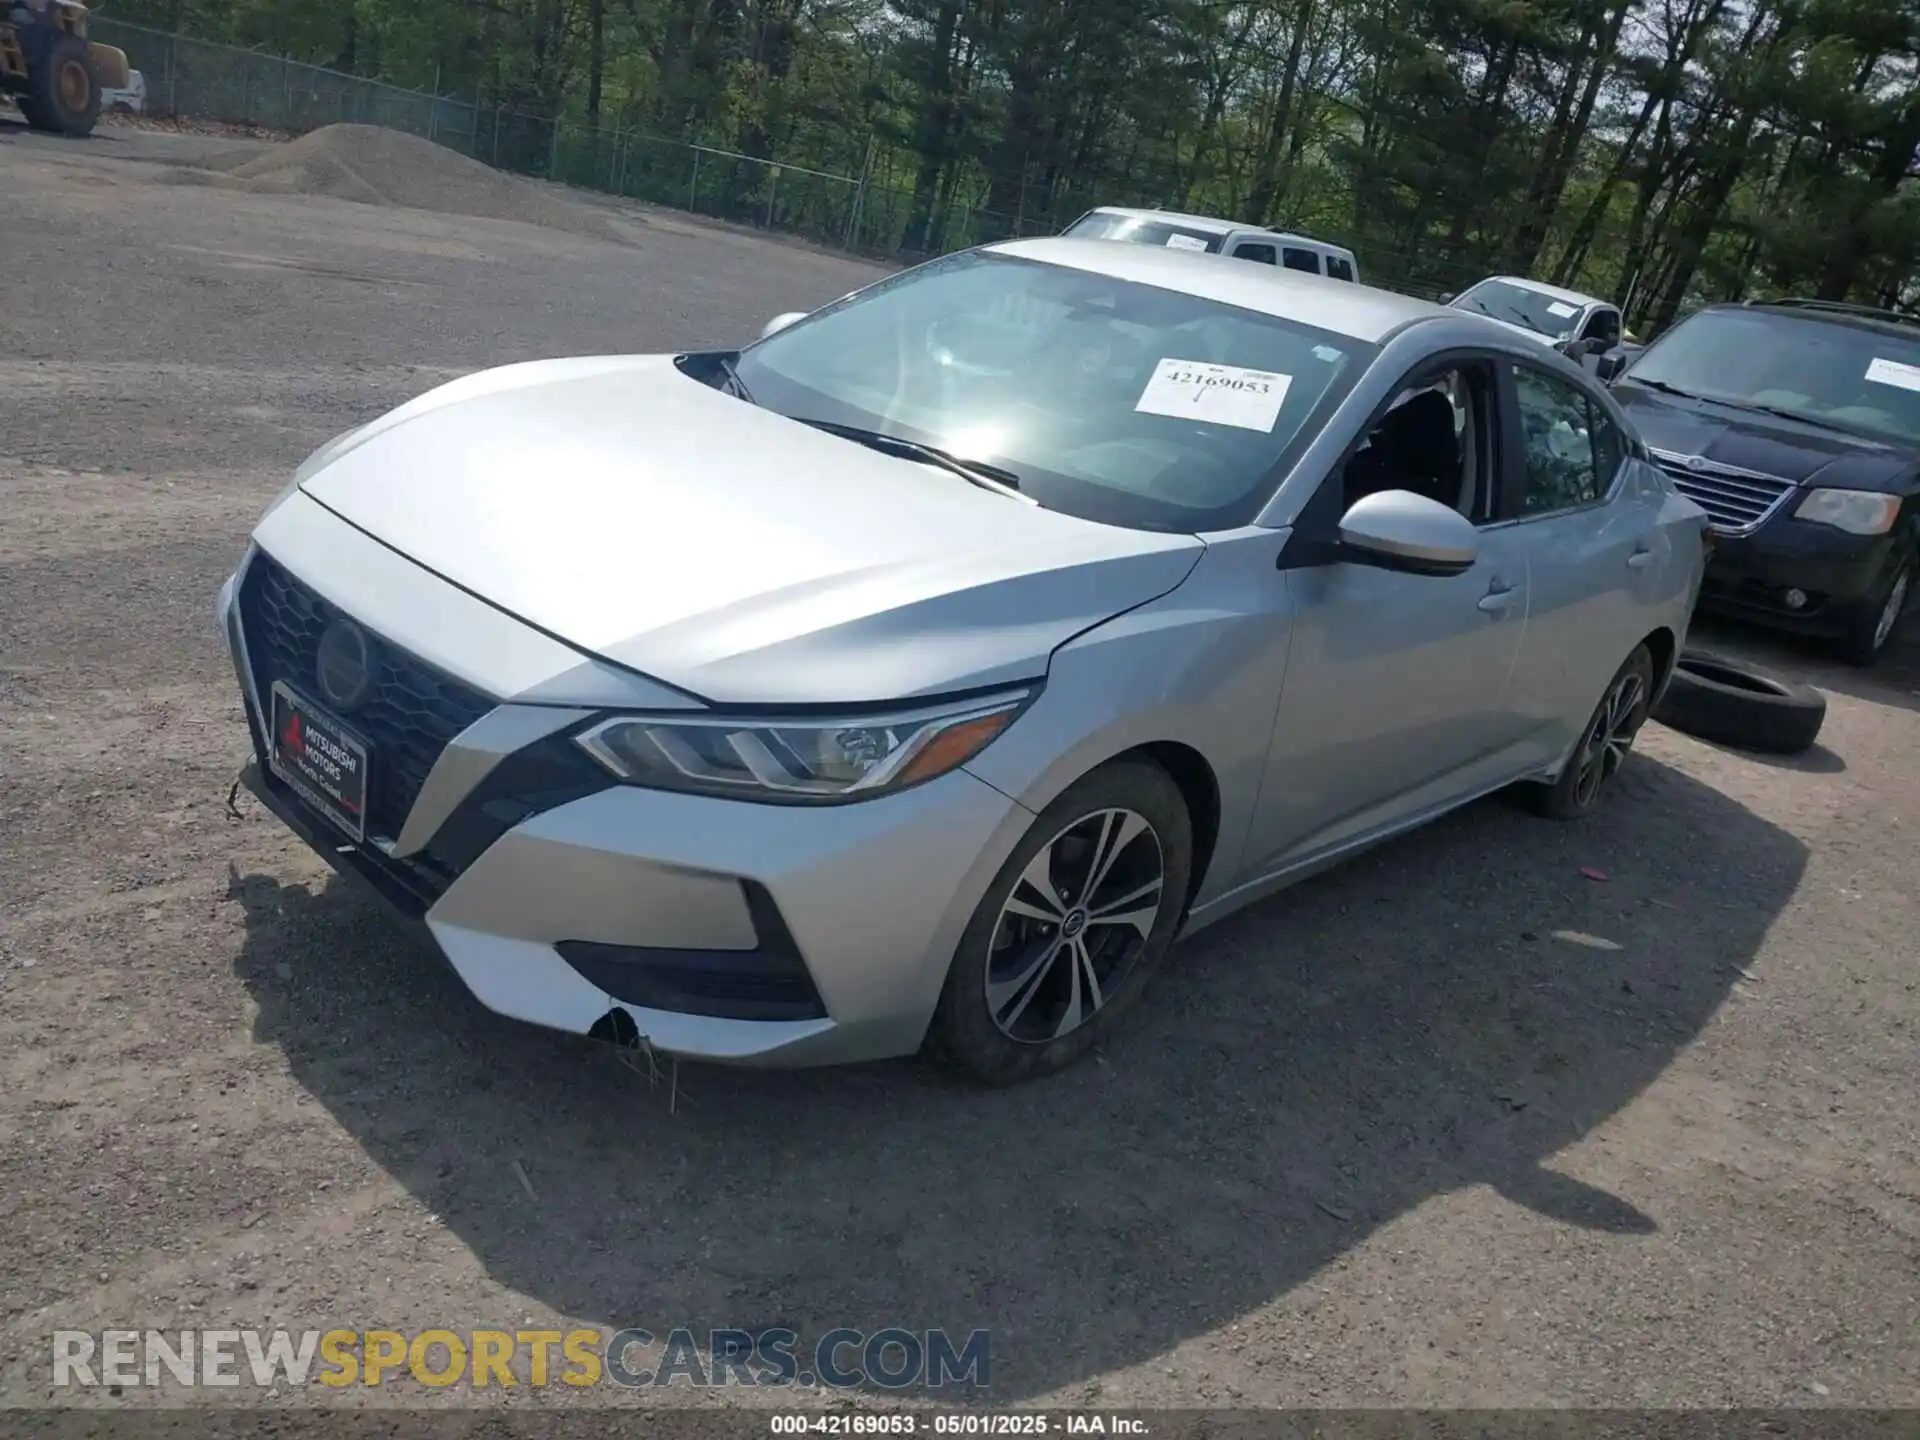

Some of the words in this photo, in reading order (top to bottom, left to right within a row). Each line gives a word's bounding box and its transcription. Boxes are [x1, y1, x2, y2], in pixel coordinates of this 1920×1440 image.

[1167, 371, 1270, 394] 42169053
[305, 725, 356, 774] MITSUBISHI
[305, 743, 341, 780] MOTORS
